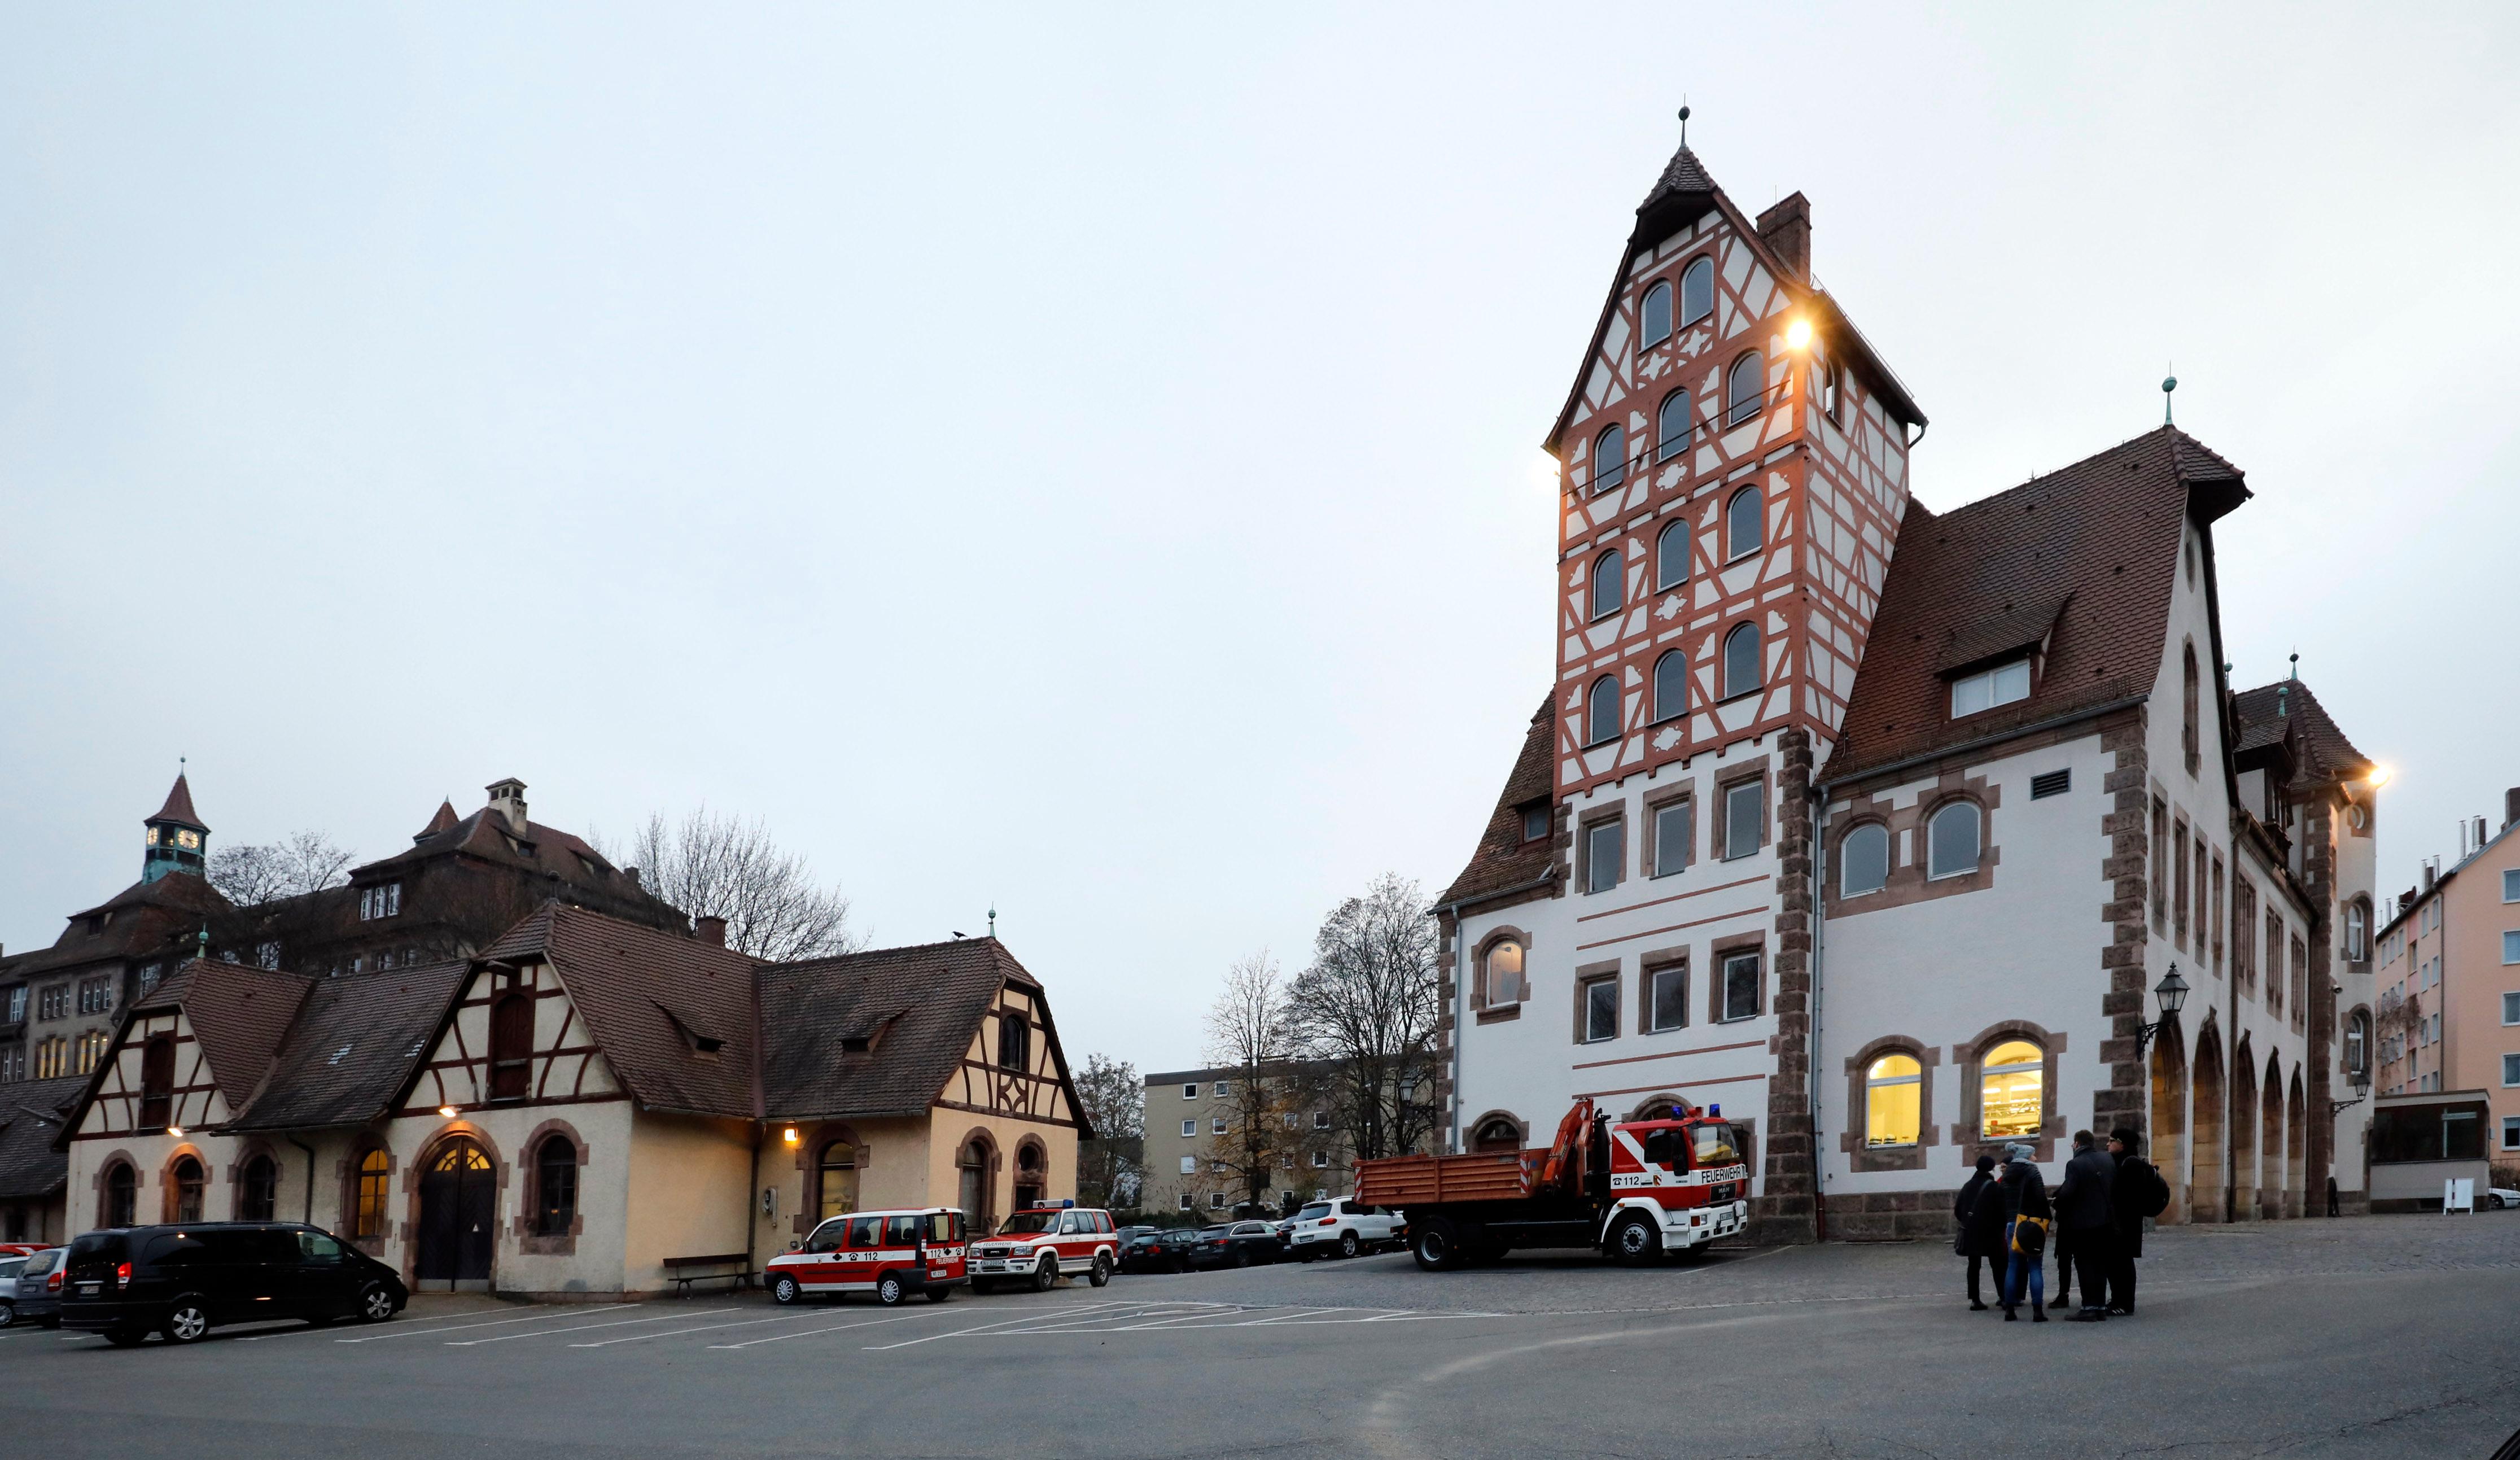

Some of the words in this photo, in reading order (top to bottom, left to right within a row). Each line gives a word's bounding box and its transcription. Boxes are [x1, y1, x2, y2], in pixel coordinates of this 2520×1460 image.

[1701, 1166, 1740, 1183] FEUERWEHR
[1624, 1177, 1639, 1185] 112
[931, 1249, 941, 1257] 112
